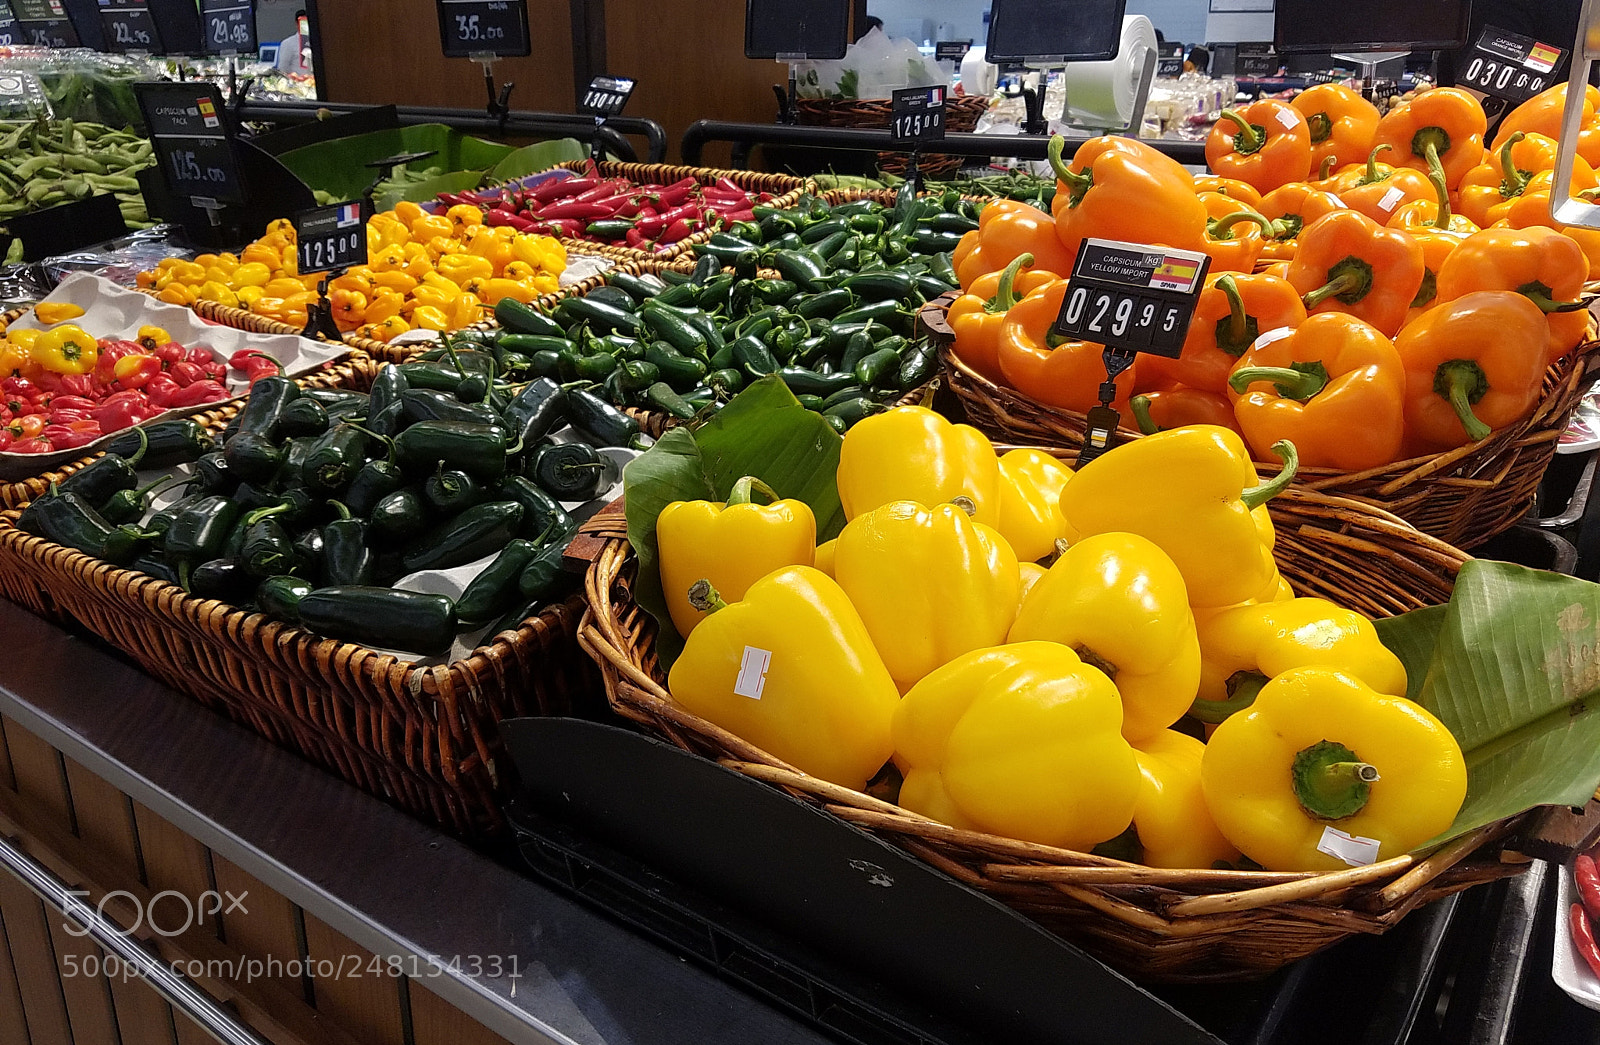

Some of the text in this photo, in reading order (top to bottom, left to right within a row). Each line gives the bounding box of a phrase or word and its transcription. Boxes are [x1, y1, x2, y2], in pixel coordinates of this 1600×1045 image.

[211, 18, 249, 43] 29.95
[455, 14, 504, 40] 35.00
[583, 91, 623, 108] 130.00
[895, 114, 939, 138] 125.00
[170, 149, 225, 181] 125.00
[304, 233, 357, 267] 125.00
[1103, 255, 1142, 268] CAPSICUM
[1090, 263, 1149, 278] YELLOW IMPORT
